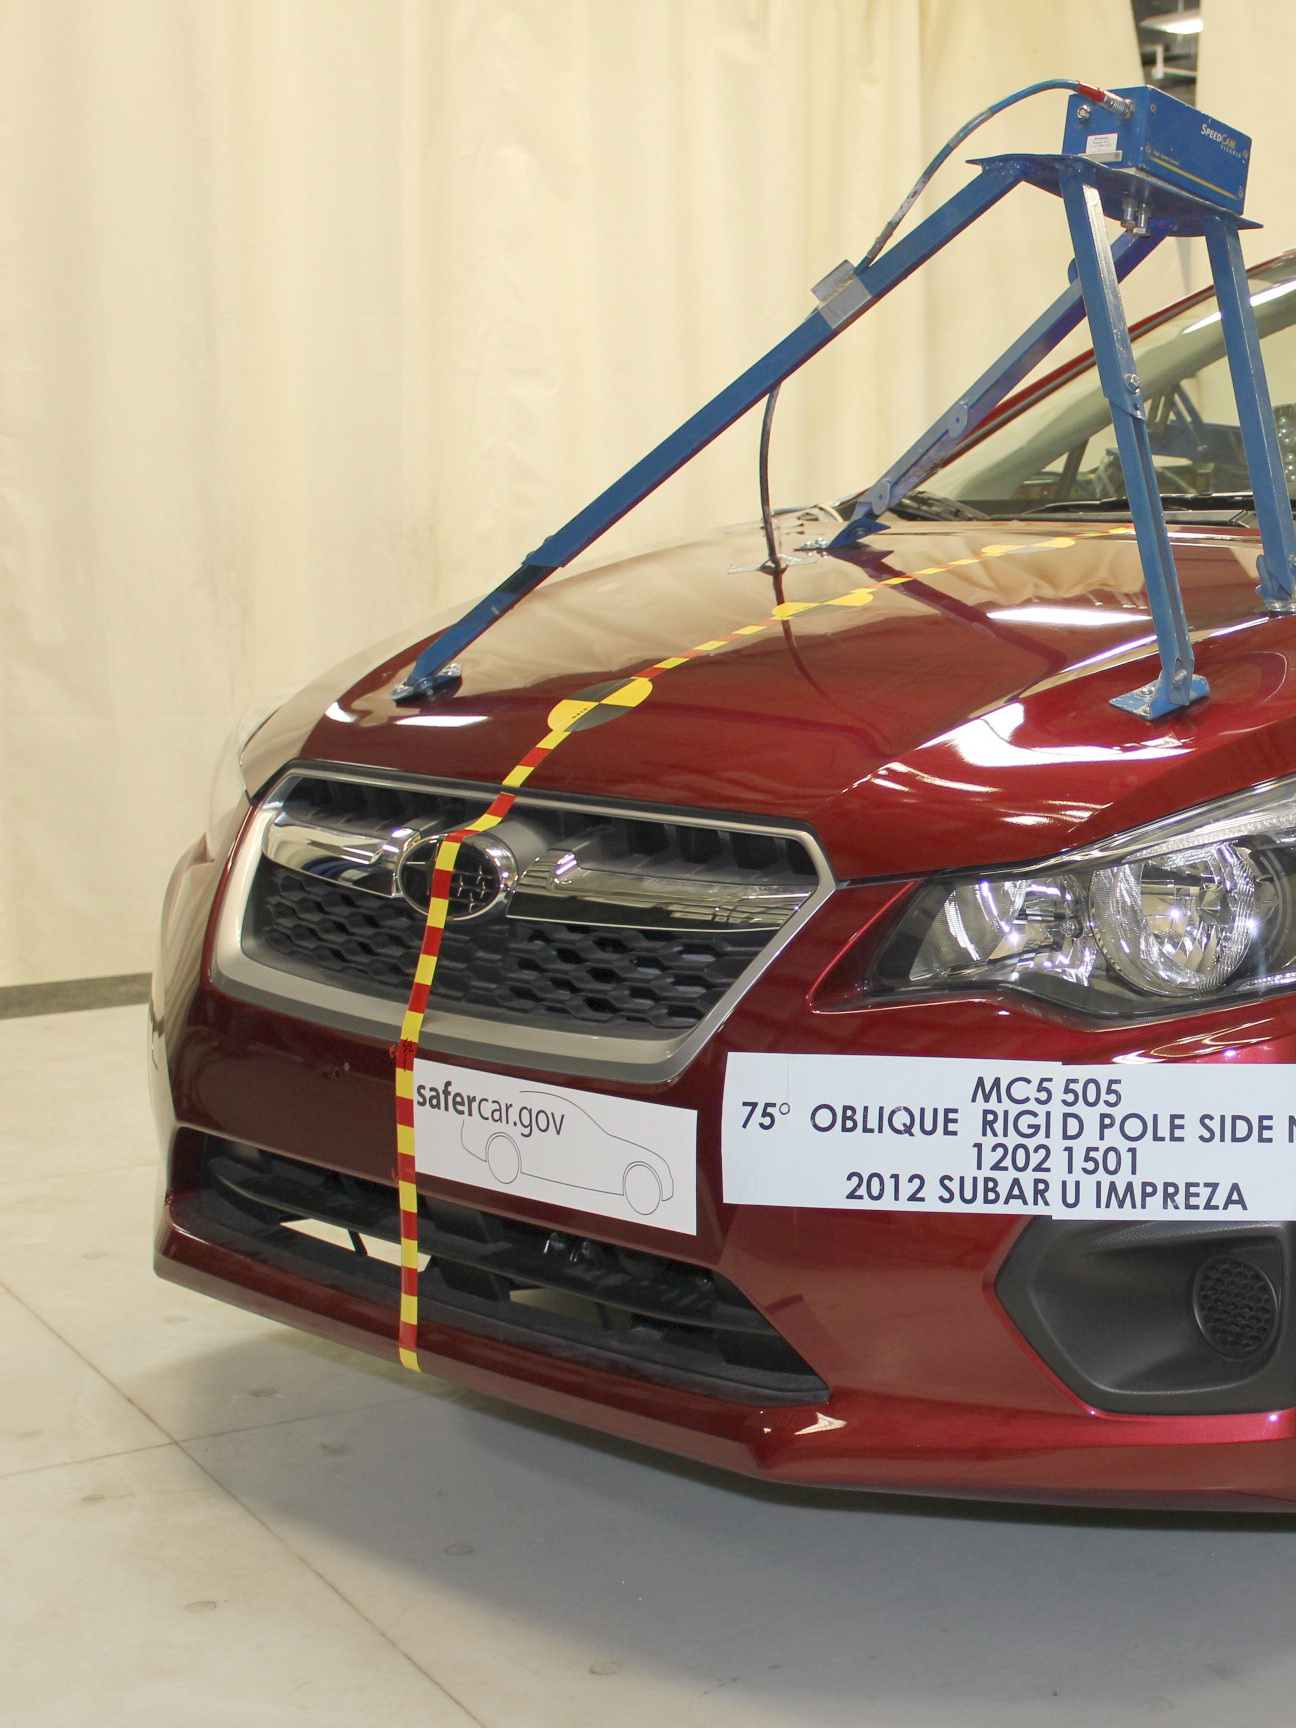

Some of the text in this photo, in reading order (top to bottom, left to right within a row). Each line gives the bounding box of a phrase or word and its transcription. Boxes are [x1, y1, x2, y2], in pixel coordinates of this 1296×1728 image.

[416, 1080, 565, 1138] safercar.gov
[810, 1103, 959, 1137] OBLIQUE
[981, 1109, 1085, 1141] RIGID
[1099, 1112, 1186, 1143] POLE
[1198, 1113, 1274, 1143] SIDE
[845, 1171, 1249, 1211] 2012 SUBARU IMPREZA
